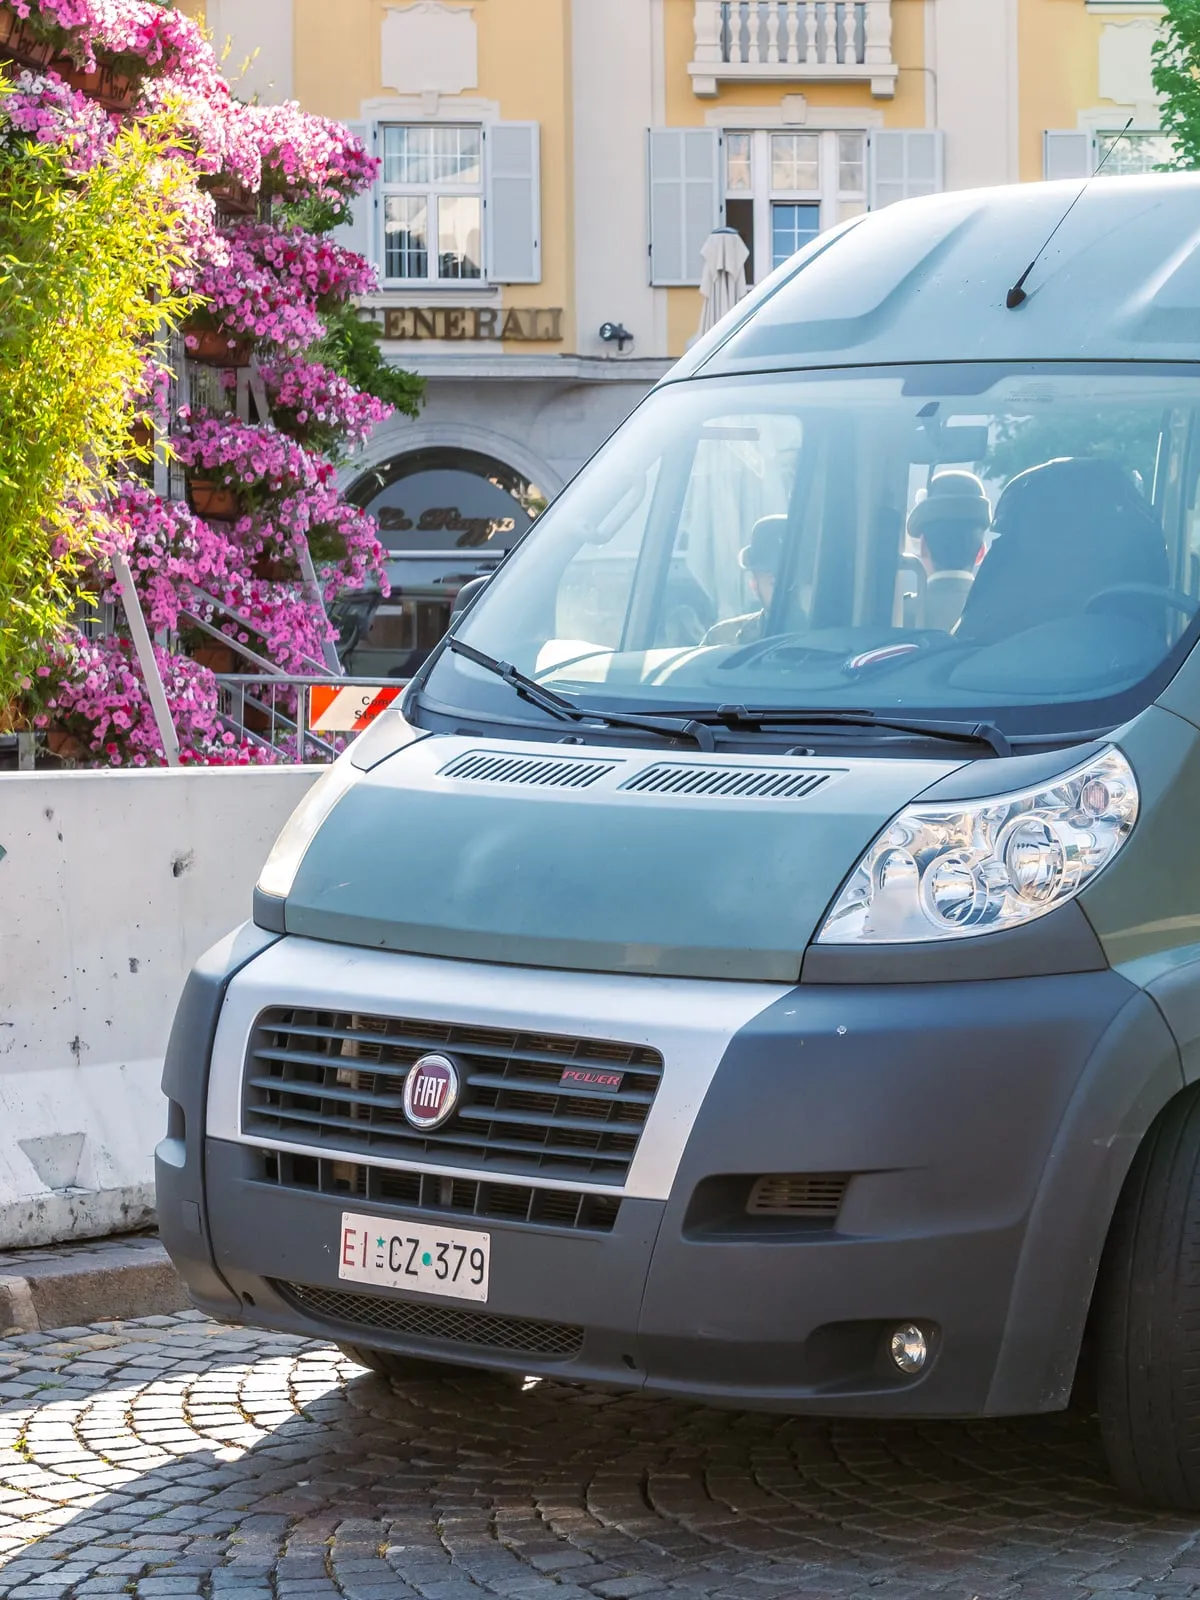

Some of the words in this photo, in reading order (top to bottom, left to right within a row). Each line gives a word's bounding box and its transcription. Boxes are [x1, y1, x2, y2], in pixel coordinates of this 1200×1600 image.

[413, 1075, 447, 1108] FIAT
[562, 1070, 621, 1086] POWER
[343, 1228, 368, 1268] EI
[434, 1242, 485, 1285] 379
